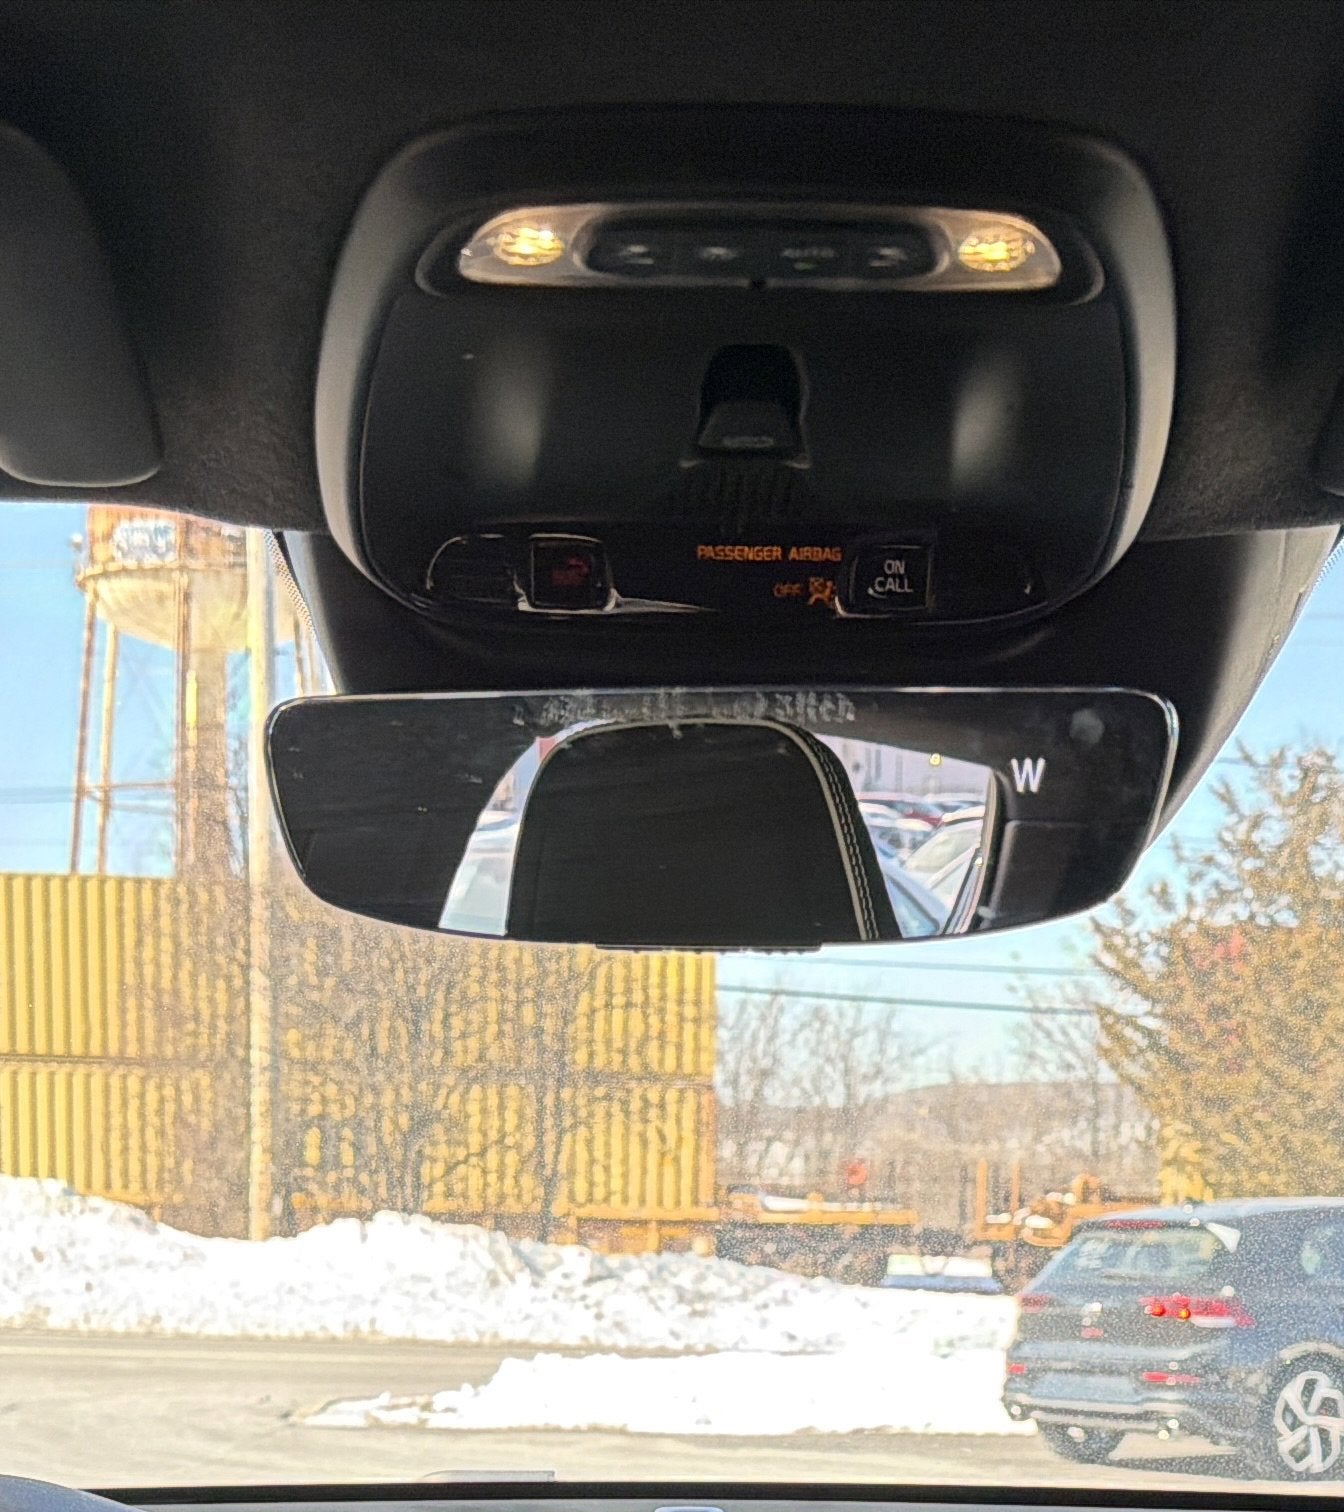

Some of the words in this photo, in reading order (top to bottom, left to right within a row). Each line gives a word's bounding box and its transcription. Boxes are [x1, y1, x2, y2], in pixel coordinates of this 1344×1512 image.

[697, 545, 782, 561] PASSENGER
[788, 546, 843, 562] AIRBAG
[884, 559, 905, 575] ON
[874, 577, 914, 593] CALL
[1011, 758, 1046, 793] W
